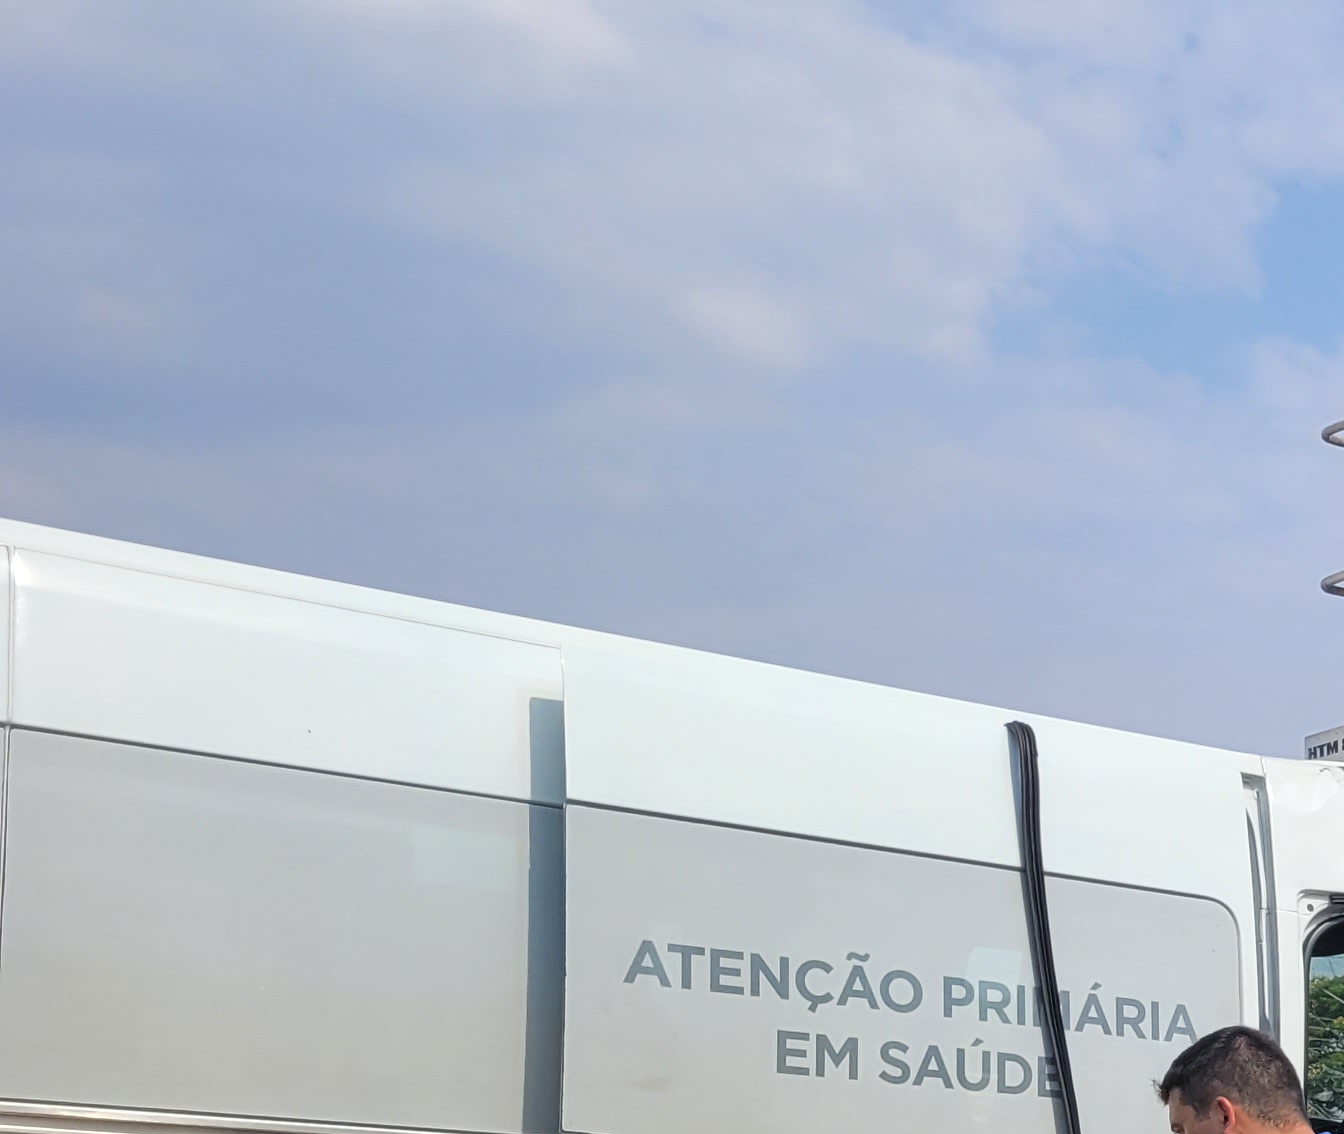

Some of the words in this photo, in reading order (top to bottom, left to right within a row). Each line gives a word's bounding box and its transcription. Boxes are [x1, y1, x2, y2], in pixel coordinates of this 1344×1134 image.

[1308, 740, 1338, 760] HTM
[623, 939, 924, 1013] ATENÇÃO
[776, 1029, 859, 1081] EM
[879, 1038, 1062, 1098] SAÚDE
